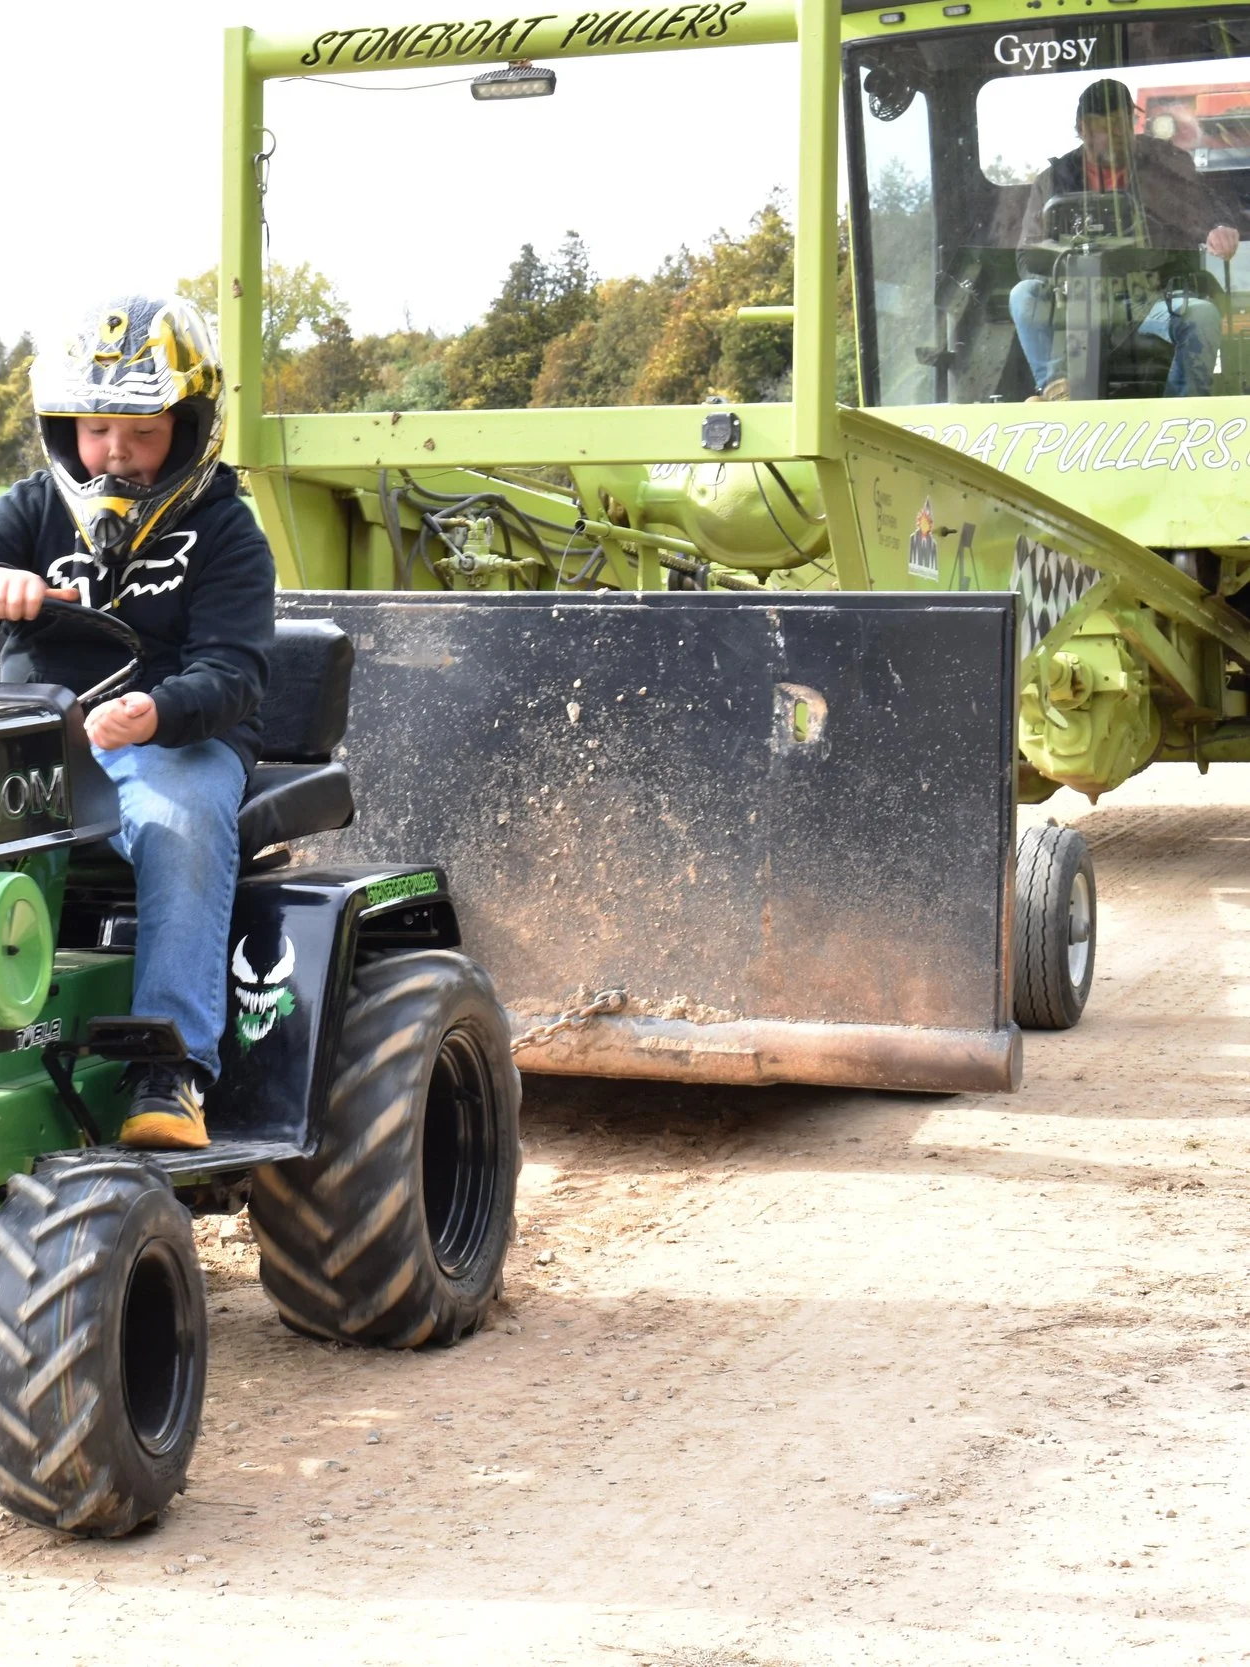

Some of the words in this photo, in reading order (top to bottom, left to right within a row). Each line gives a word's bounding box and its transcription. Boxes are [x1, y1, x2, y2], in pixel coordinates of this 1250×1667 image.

[301, 15, 558, 66] STONEBOAT
[560, 1, 747, 49] PULLERS
[994, 34, 1097, 71] Gypsy
[901, 417, 1250, 474] OATPULLERS.
